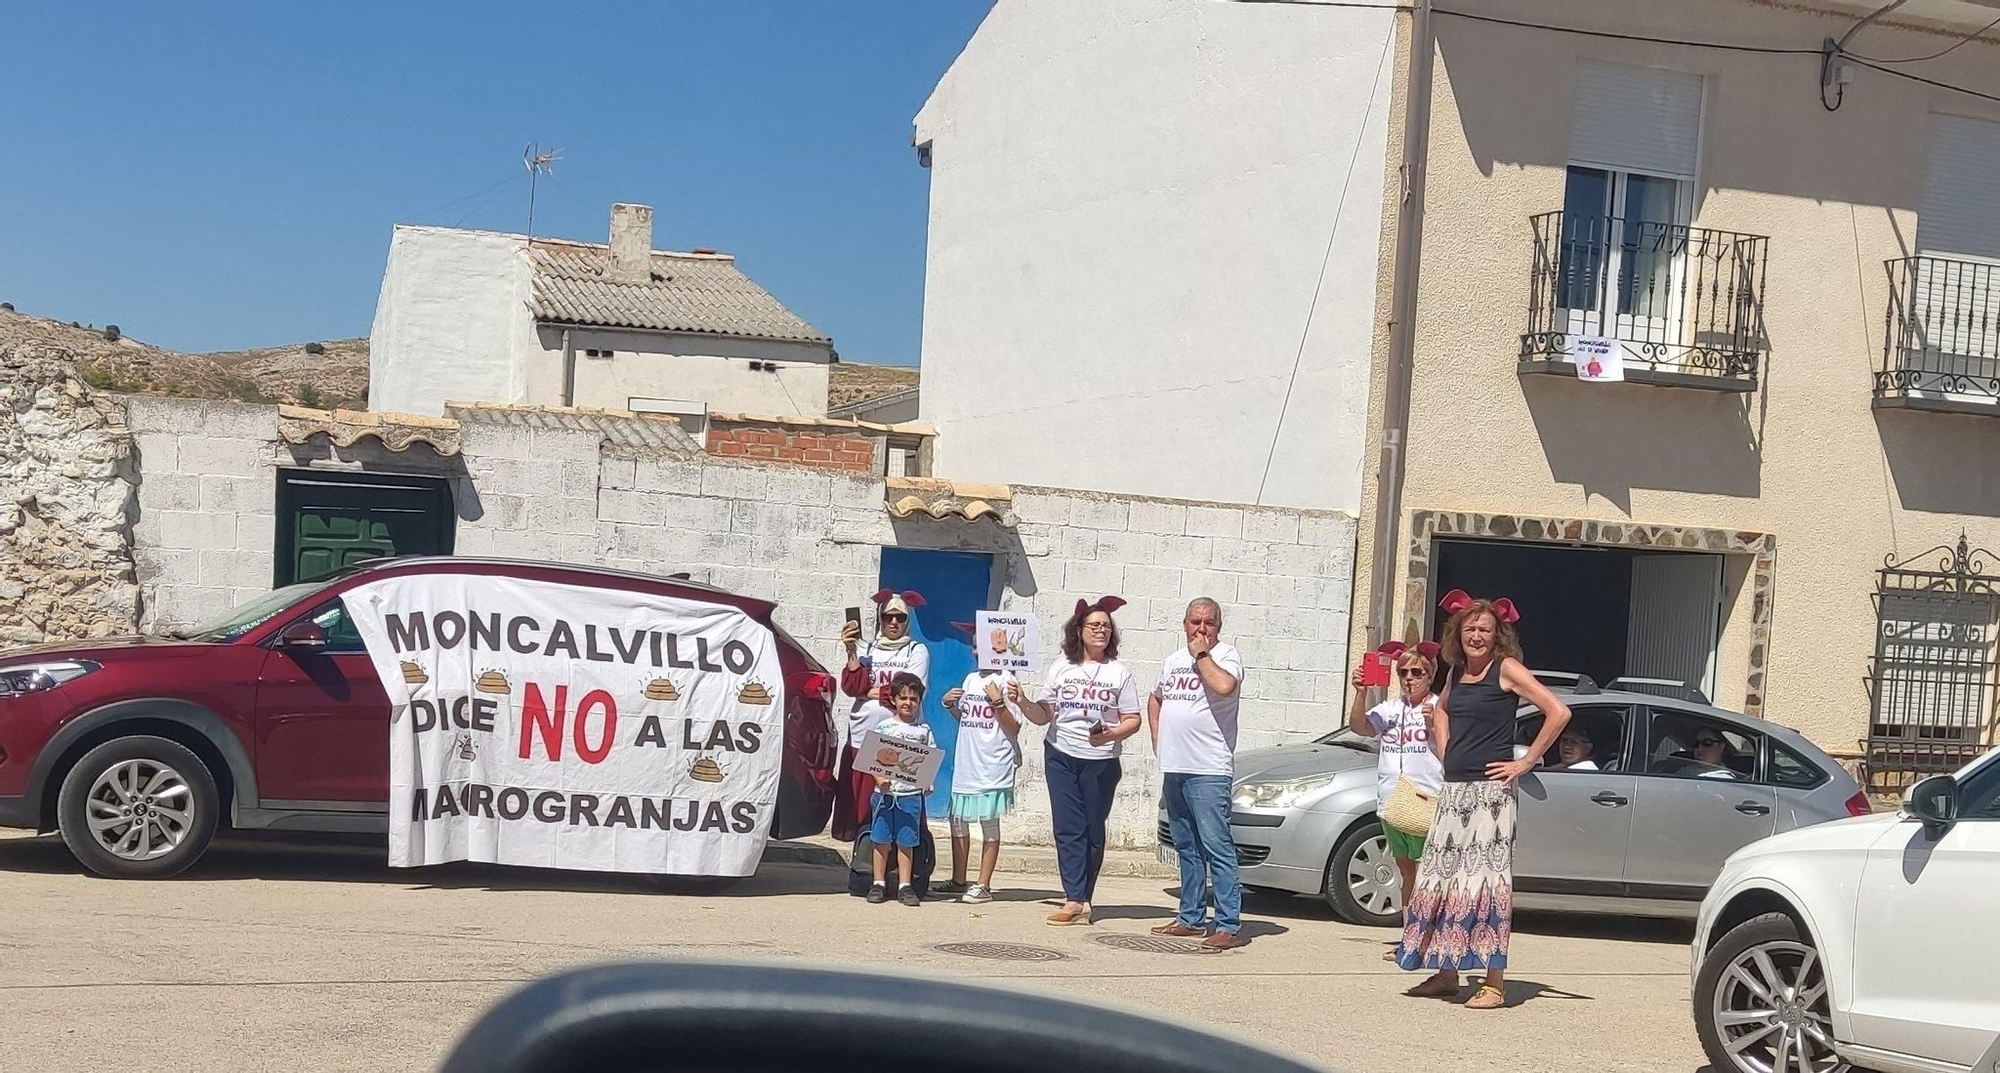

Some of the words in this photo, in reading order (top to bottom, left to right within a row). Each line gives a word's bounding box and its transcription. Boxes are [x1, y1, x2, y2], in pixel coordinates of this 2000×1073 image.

[385, 610, 754, 675] MONCALVILLO
[1176, 676, 1202, 690] NO
[1081, 688, 1110, 701] NO
[971, 705, 996, 719] NO
[410, 695, 497, 733] DICE
[518, 682, 618, 765] NO
[634, 715, 666, 748] A
[683, 718, 763, 754] LAS
[960, 720, 994, 729] ONCALVILLO
[1402, 729, 1429, 742] NO
